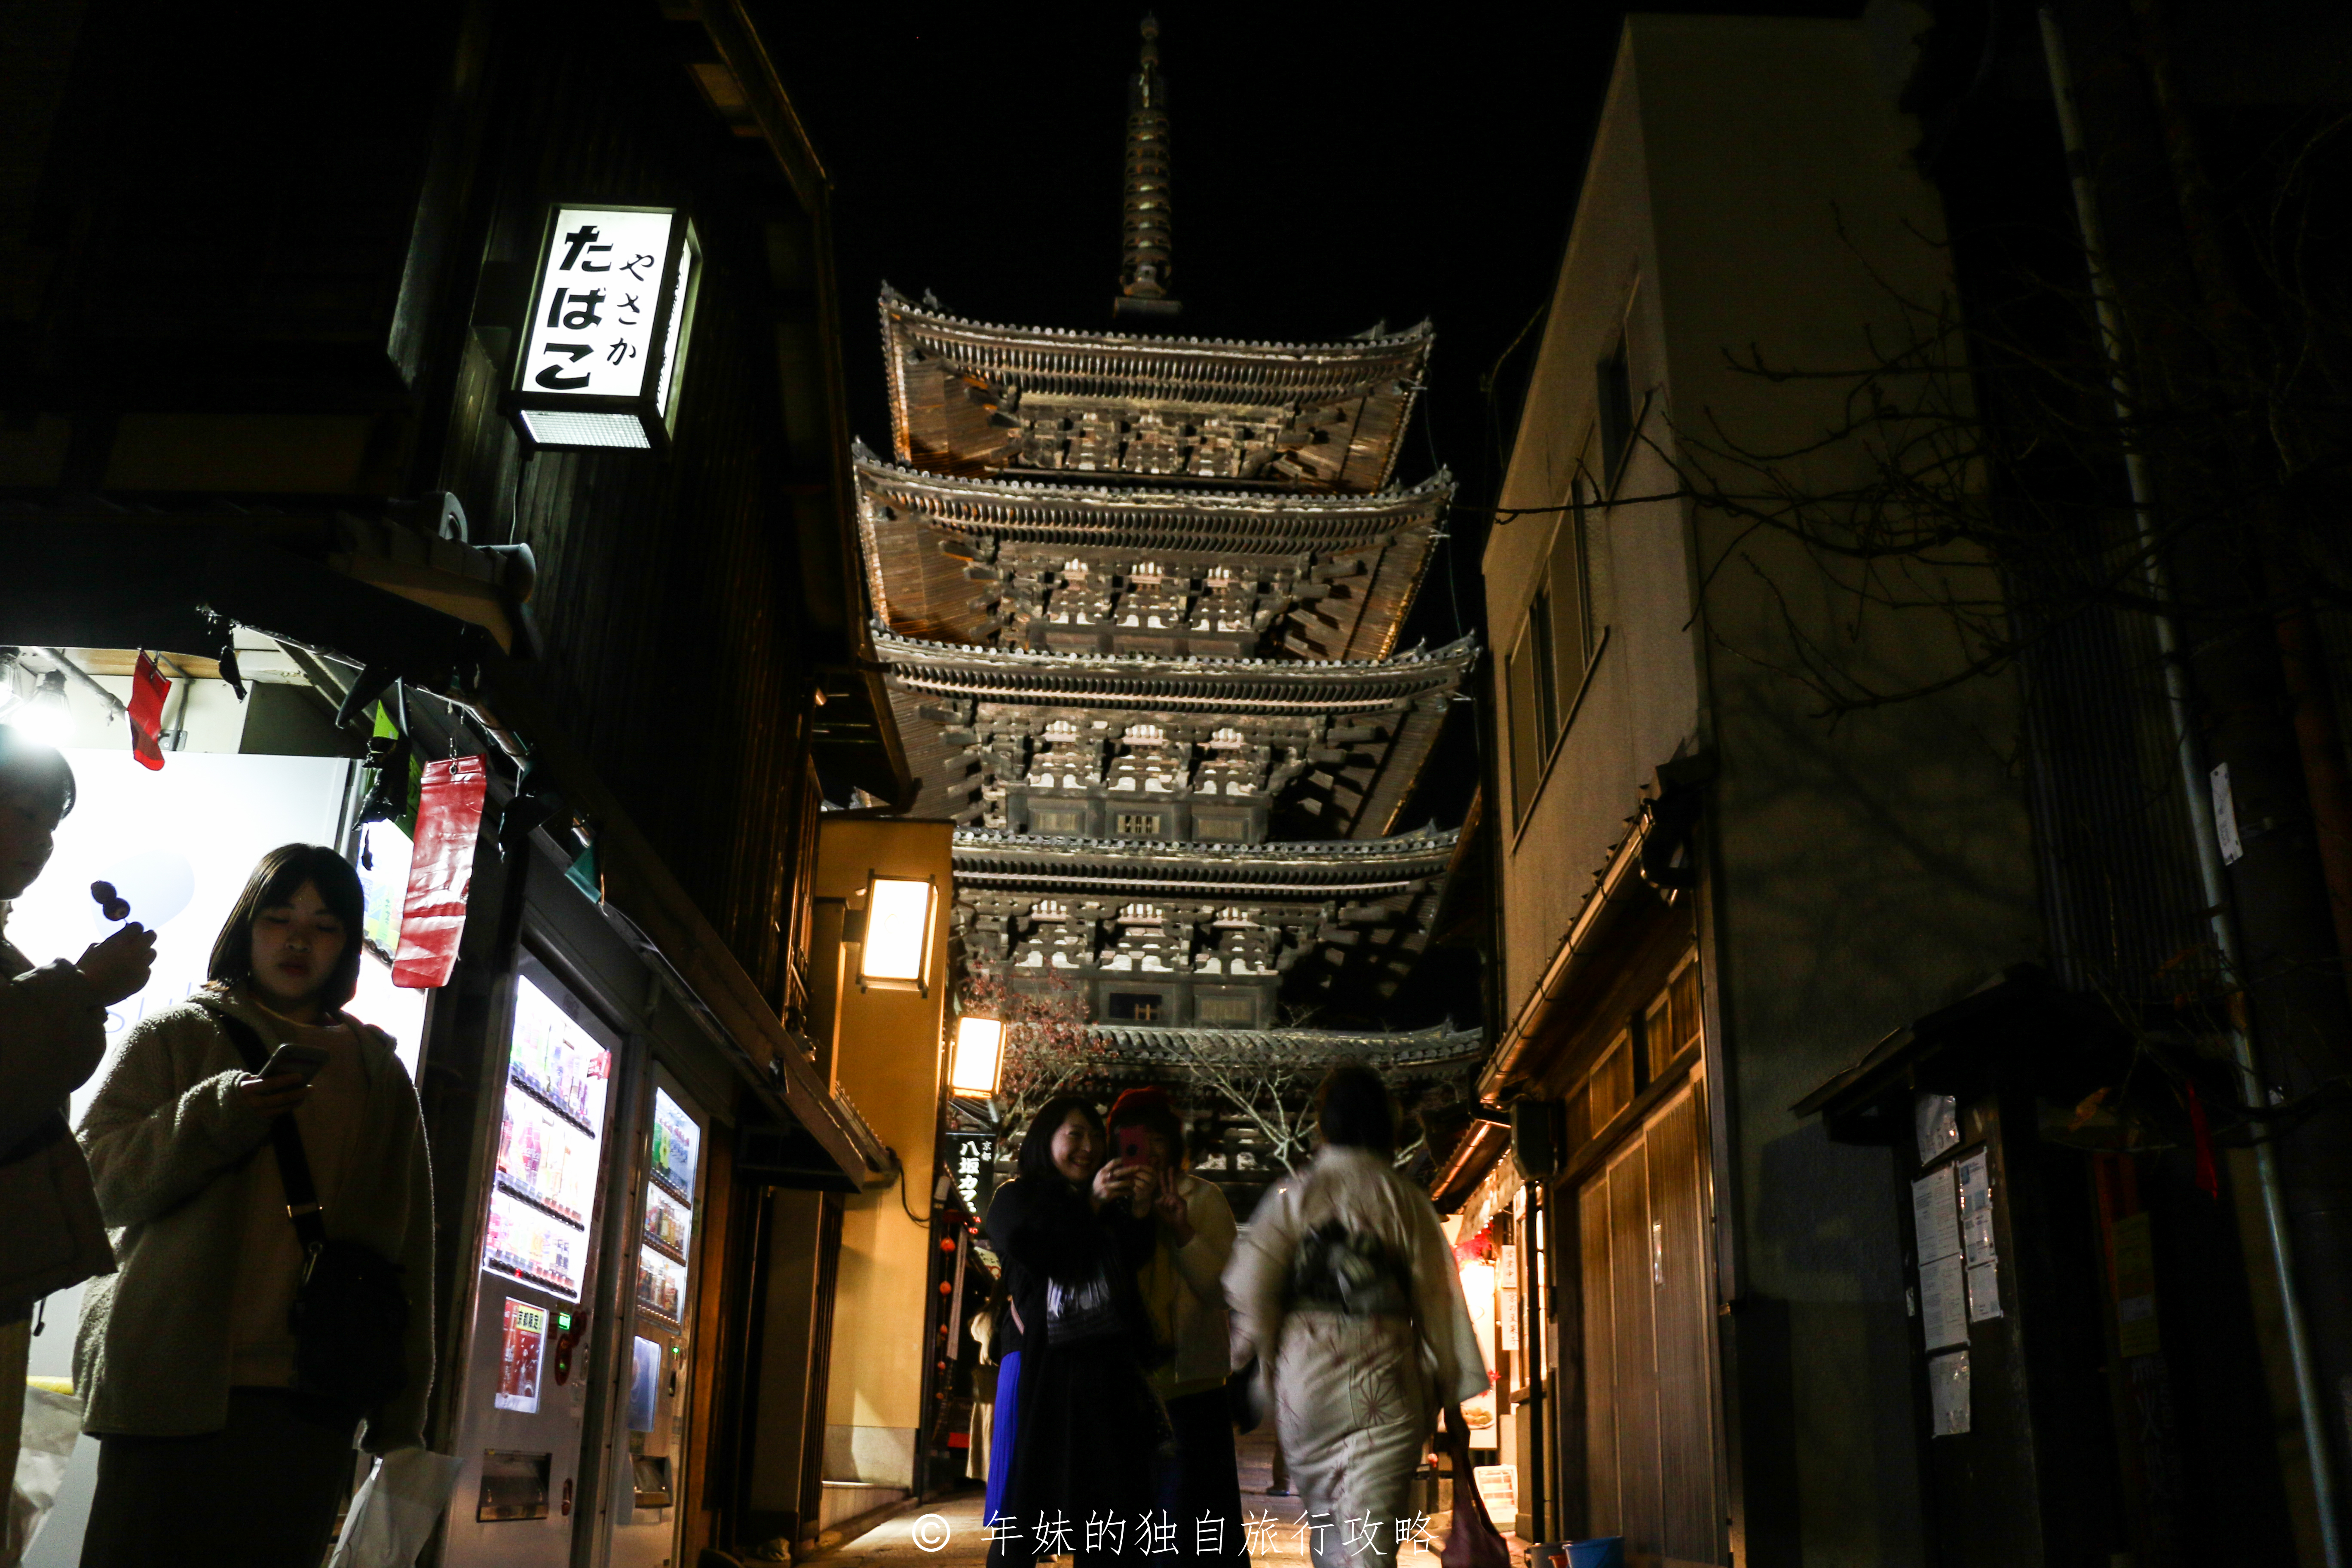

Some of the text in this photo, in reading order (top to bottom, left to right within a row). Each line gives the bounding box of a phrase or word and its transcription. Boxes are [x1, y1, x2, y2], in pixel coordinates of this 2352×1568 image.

[535, 225, 614, 390] たばこ
[606, 254, 655, 366] やさか
[981, 1141, 992, 1161] 京都
